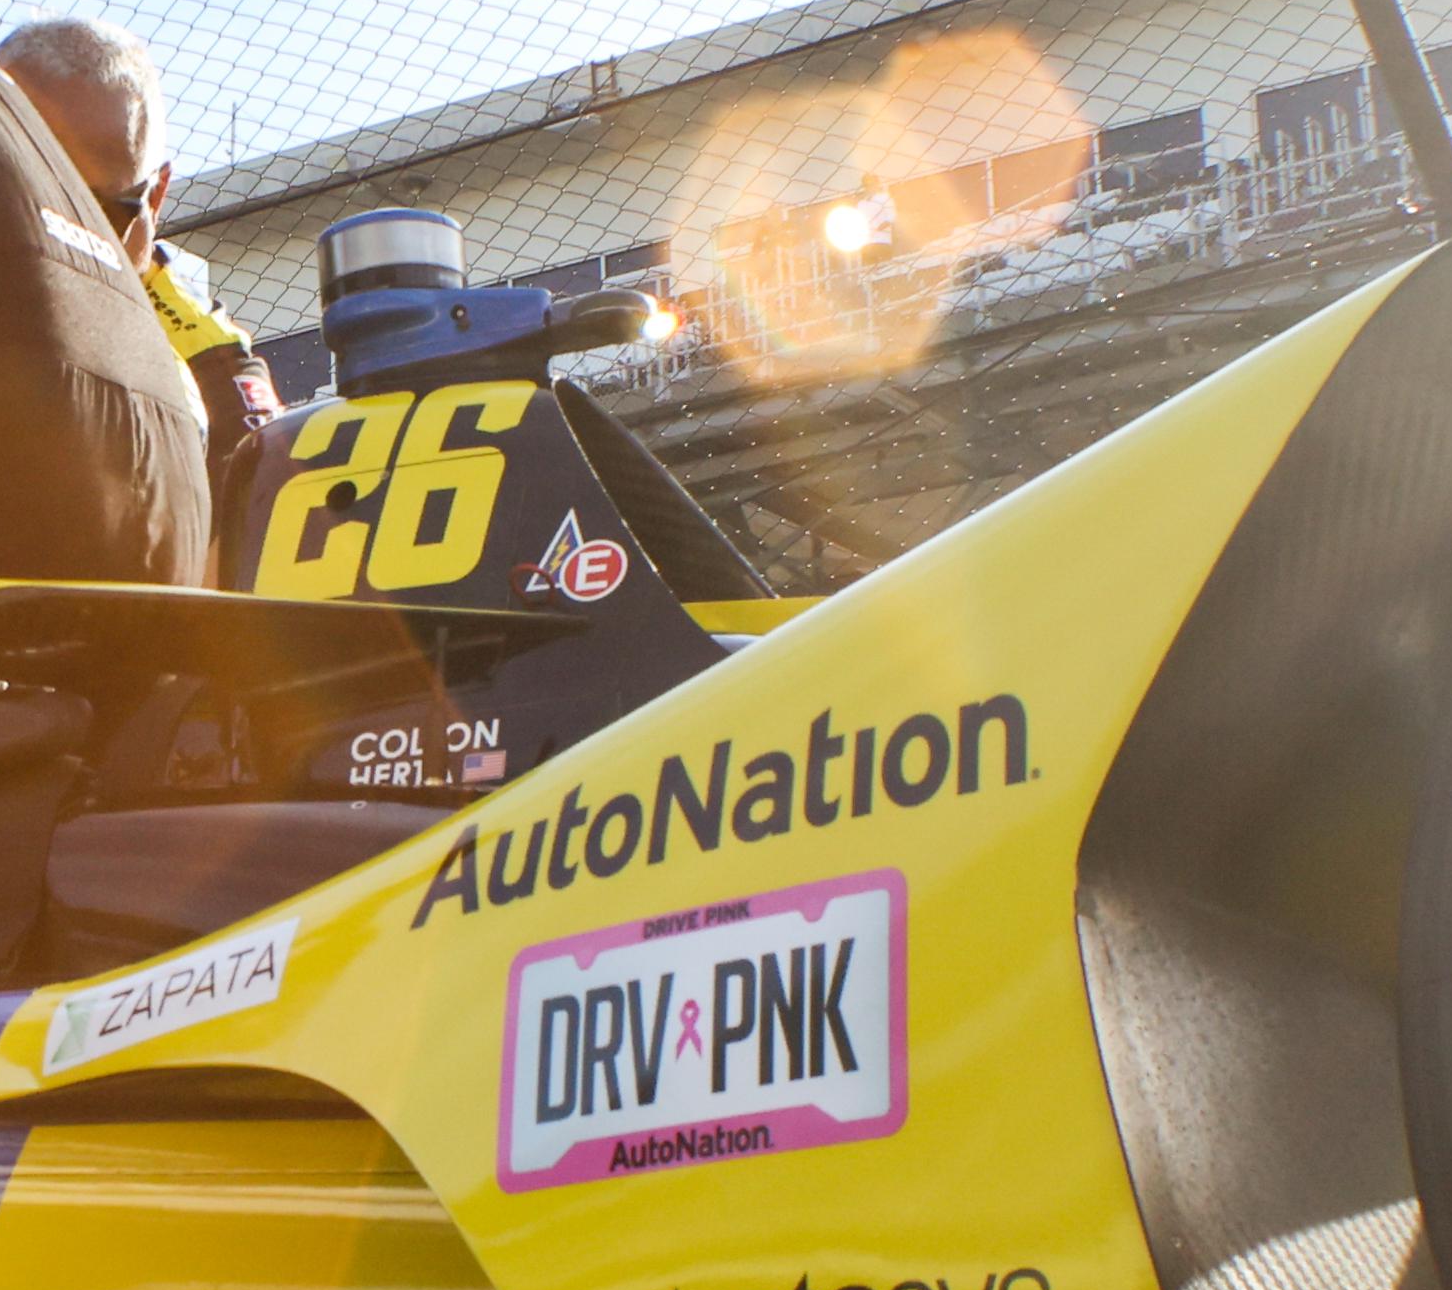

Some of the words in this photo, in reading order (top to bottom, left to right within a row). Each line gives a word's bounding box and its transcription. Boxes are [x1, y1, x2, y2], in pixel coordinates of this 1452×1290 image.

[253, 380, 535, 600] 26
[349, 760, 453, 786] HERT
[351, 719, 500, 762] COLON
[411, 692, 1030, 929] AutoNation
[643, 909, 699, 940] DRIVE
[703, 901, 750, 926] PINK
[99, 941, 276, 1037] ZAPATA
[536, 973, 673, 1124] DRV
[712, 938, 858, 1092] PNK
[608, 1123, 770, 1172] AutoNation
